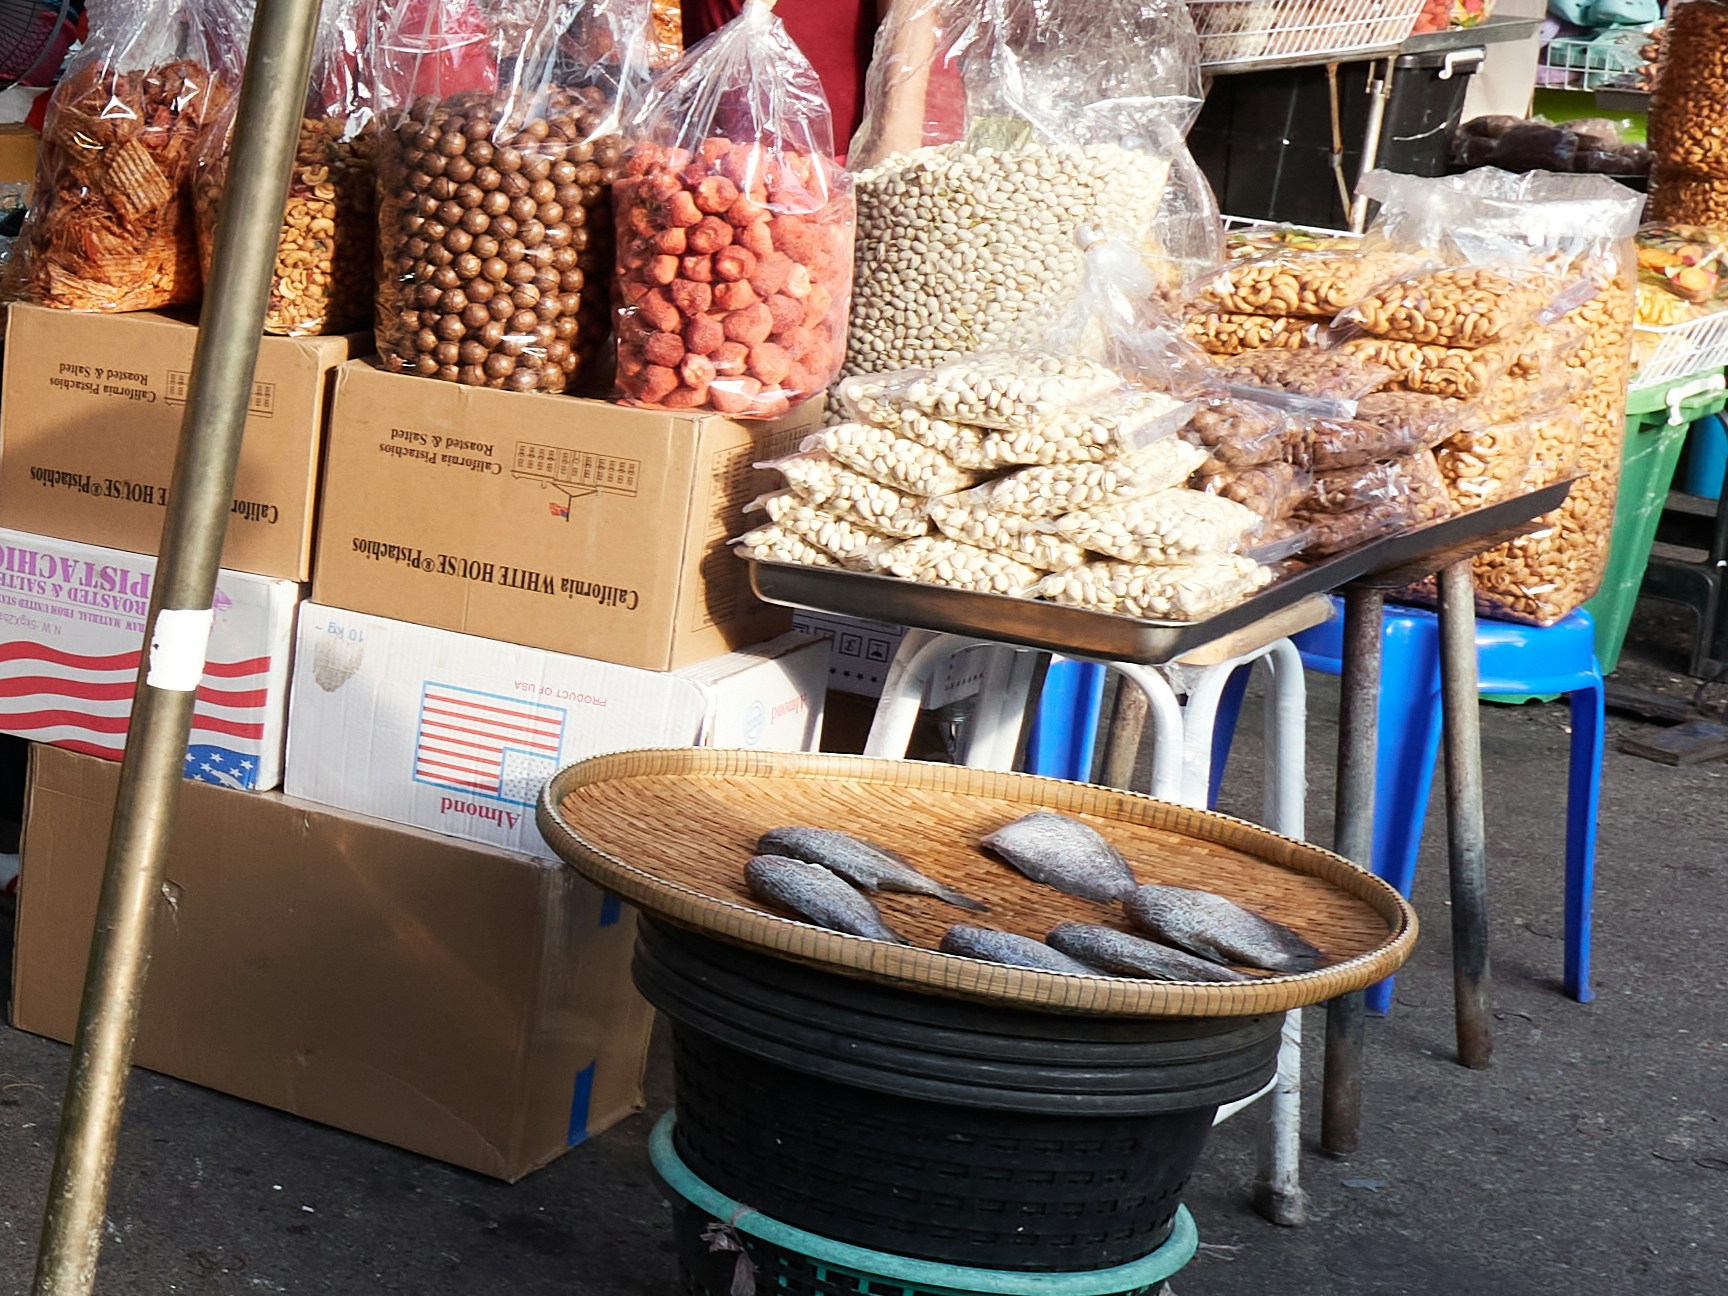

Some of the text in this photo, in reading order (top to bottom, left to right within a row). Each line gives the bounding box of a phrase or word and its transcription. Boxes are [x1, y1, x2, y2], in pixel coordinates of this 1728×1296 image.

[58, 362, 149, 386] Roasted & Salted
[49, 377, 157, 403] California Pistachios
[390, 428, 494, 457] Roasted & Salted
[378, 442, 503, 475] California Pistachios
[229, 499, 279, 525] Califor
[51, 583, 63, 599] &
[498, 565, 555, 596] WHITE
[18, 597, 49, 613] UNITED
[67, 587, 147, 616] ROASTED
[560, 577, 640, 611] California
[50, 604, 75, 619] FROM
[78, 610, 122, 628] MATERIAL
[125, 619, 146, 633] RAW
[326, 621, 345, 640] kg
[513, 679, 607, 708] PRODUCT OF USA
[440, 796, 521, 830] Almond
